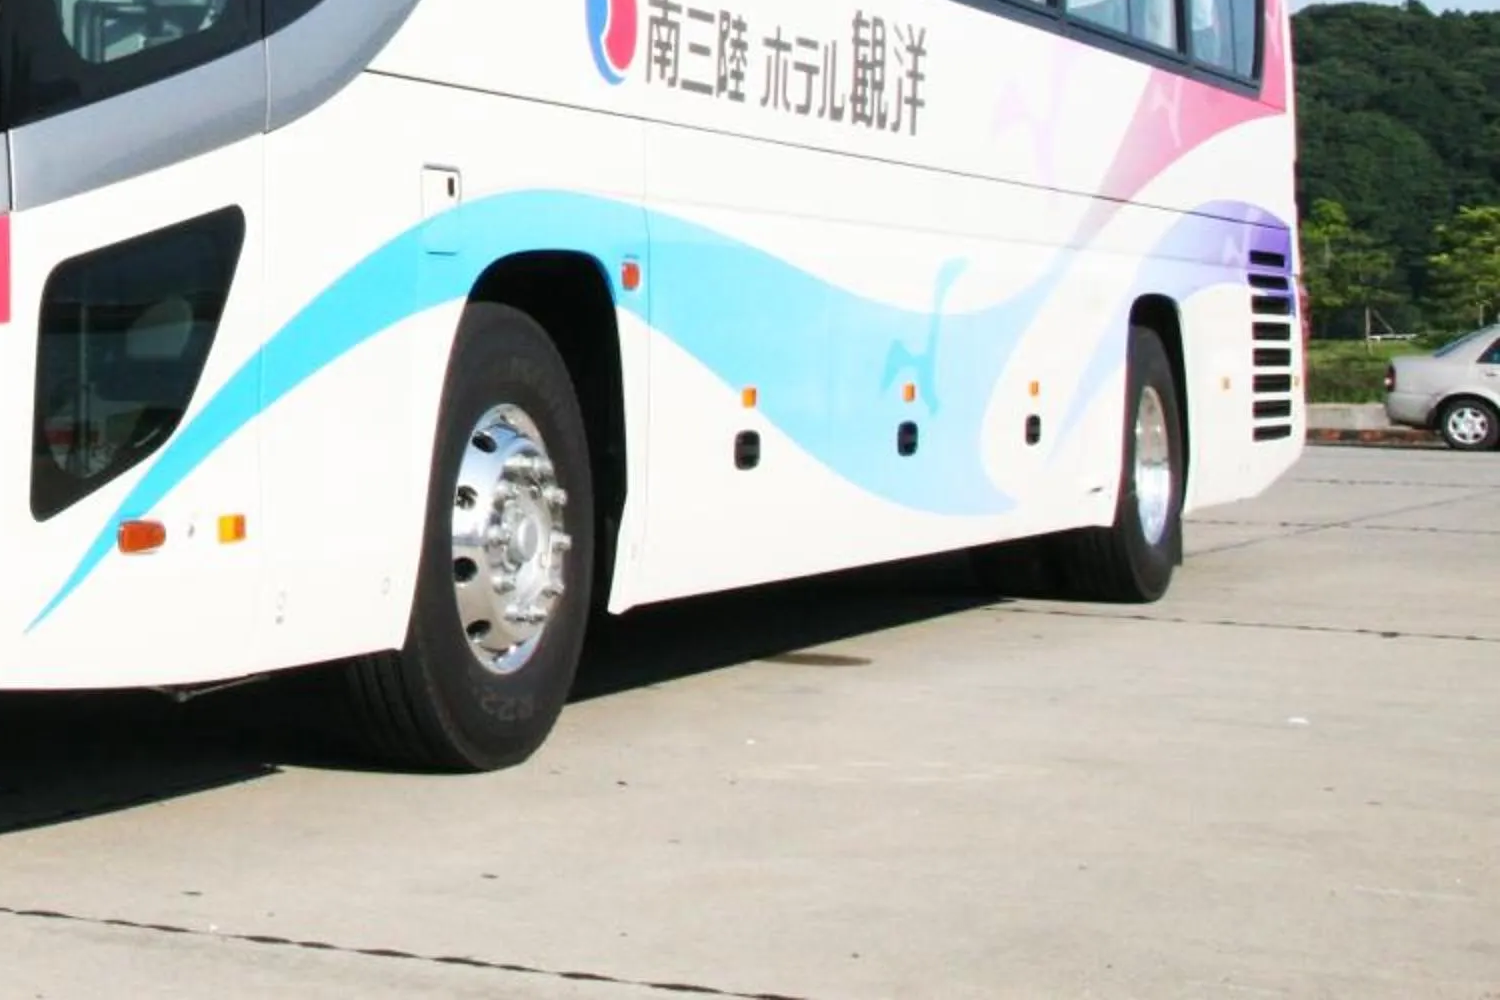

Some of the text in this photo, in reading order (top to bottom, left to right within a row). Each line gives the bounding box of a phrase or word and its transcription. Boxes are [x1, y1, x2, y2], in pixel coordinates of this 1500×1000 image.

[760, 9, 927, 136] ホテル観洋
